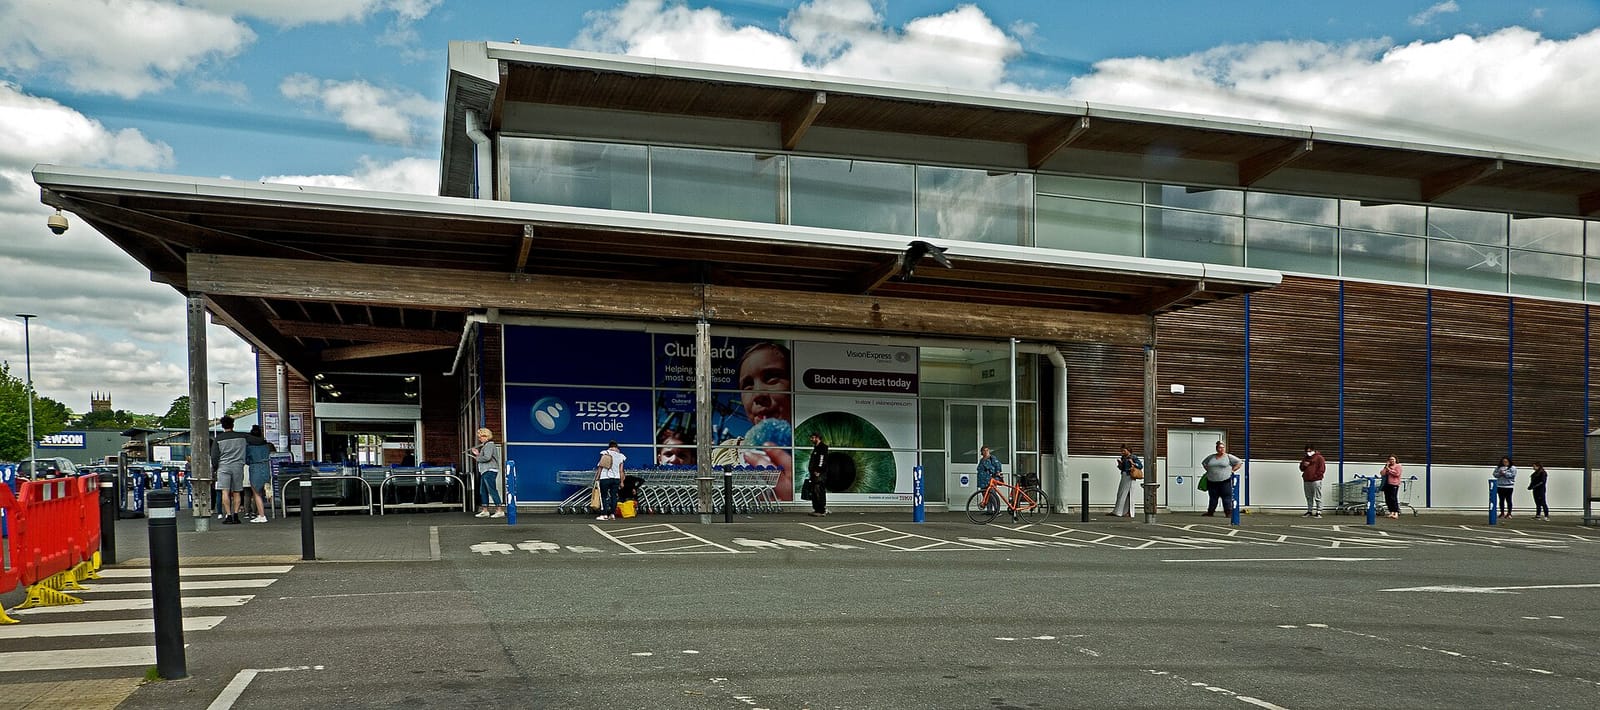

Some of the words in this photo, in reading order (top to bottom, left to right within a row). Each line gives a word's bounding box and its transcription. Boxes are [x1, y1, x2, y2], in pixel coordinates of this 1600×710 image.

[664, 343, 735, 359] Clubard
[665, 365, 694, 375] Helping
[723, 367, 736, 375] the
[814, 374, 837, 384] Book
[839, 377, 850, 385] an
[852, 377, 868, 388] eye
[869, 377, 886, 387] test
[887, 378, 912, 390] today
[575, 401, 630, 413] TESCO
[582, 418, 624, 432] mobile
[41, 434, 84, 444] EWSON
